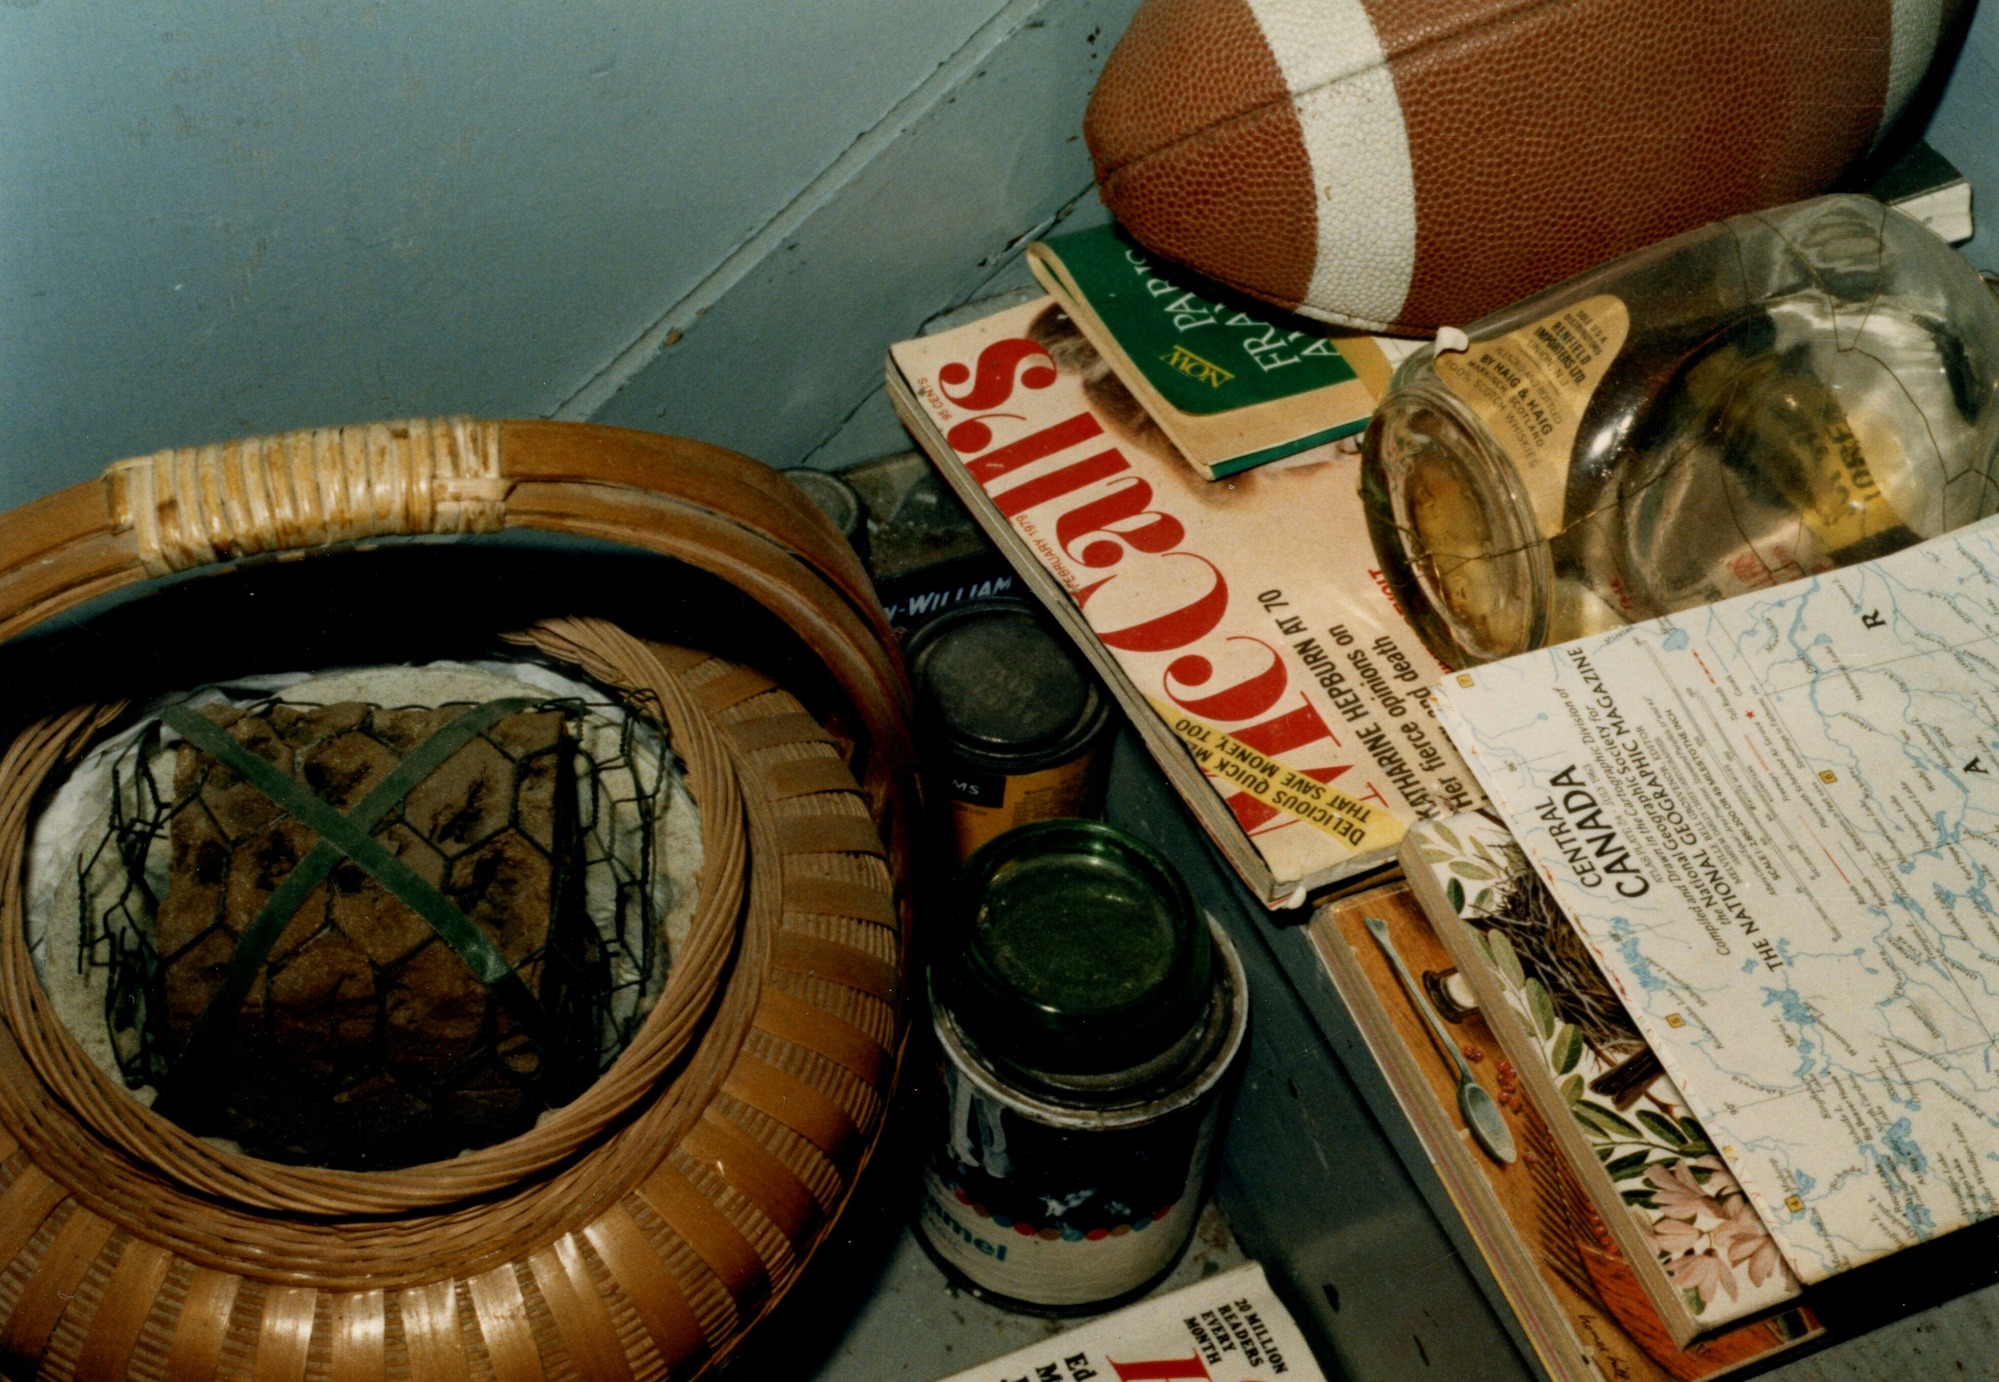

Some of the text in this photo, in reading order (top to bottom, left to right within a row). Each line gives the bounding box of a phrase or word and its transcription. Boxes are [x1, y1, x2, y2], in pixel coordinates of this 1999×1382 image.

[1533, 326, 1575, 370] IMPORTERS
[1550, 320, 1592, 366] RENFIELD
[1157, 345, 1233, 388] NOW
[1479, 352, 1553, 436] BY HAIG & HAIG
[1508, 395, 1544, 447] SCOTLAND
[1015, 510, 1080, 593] FEBRUARY 1979
[938, 338, 1388, 837] McCall's
[1257, 588, 1289, 614] 70
[1274, 615, 1307, 636] AT
[1328, 624, 1355, 647] on
[1861, 609, 1887, 630] R
[1293, 637, 1369, 723] HEPBURN
[1371, 635, 1419, 683] death
[1346, 649, 1407, 718] opinions
[1567, 647, 1629, 737] MAGAZINE
[1664, 709, 1683, 731] INCH
[1677, 730, 1693, 751] THE
[1400, 721, 1446, 773] fierce
[1635, 725, 1662, 761] EDITOR
[1962, 755, 1989, 775] A
[1174, 719, 1371, 824] THAT SAVE MONEY, TOO
[1214, 757, 1270, 795] QUICK
[1354, 718, 1442, 825] KATHARINE
[1433, 769, 1475, 814] Her
[1582, 763, 1601, 784] 1963
[1621, 739, 1698, 846] GEOGRAPHIC
[1695, 760, 1716, 786] MILES
[1711, 786, 1723, 797] 45
[1271, 790, 1366, 847] DELICIOUS
[1585, 705, 1731, 926] the National Geographic Society for
[1594, 785, 1615, 807] JULY
[1718, 797, 1732, 810] OR
[1549, 764, 1650, 899] CANADA
[1552, 682, 1732, 956] Compiled and Drawn in the Cartographic Division of
[1621, 826, 1646, 856] PLATE
[1690, 814, 1713, 842] BELL
[1534, 796, 1603, 888] CENTRAL
[1640, 855, 1664, 884] ATLAS
[1758, 854, 1781, 881] SCALE
[1692, 848, 1760, 936] NATIONAL
[1752, 938, 1784, 972] THE
[1183, 1316, 1222, 1365] MONTH
[1200, 1310, 1237, 1353] EVERY
[1217, 1304, 1264, 1368] READERS
[1233, 1298, 1288, 1374] 20 MILLION
